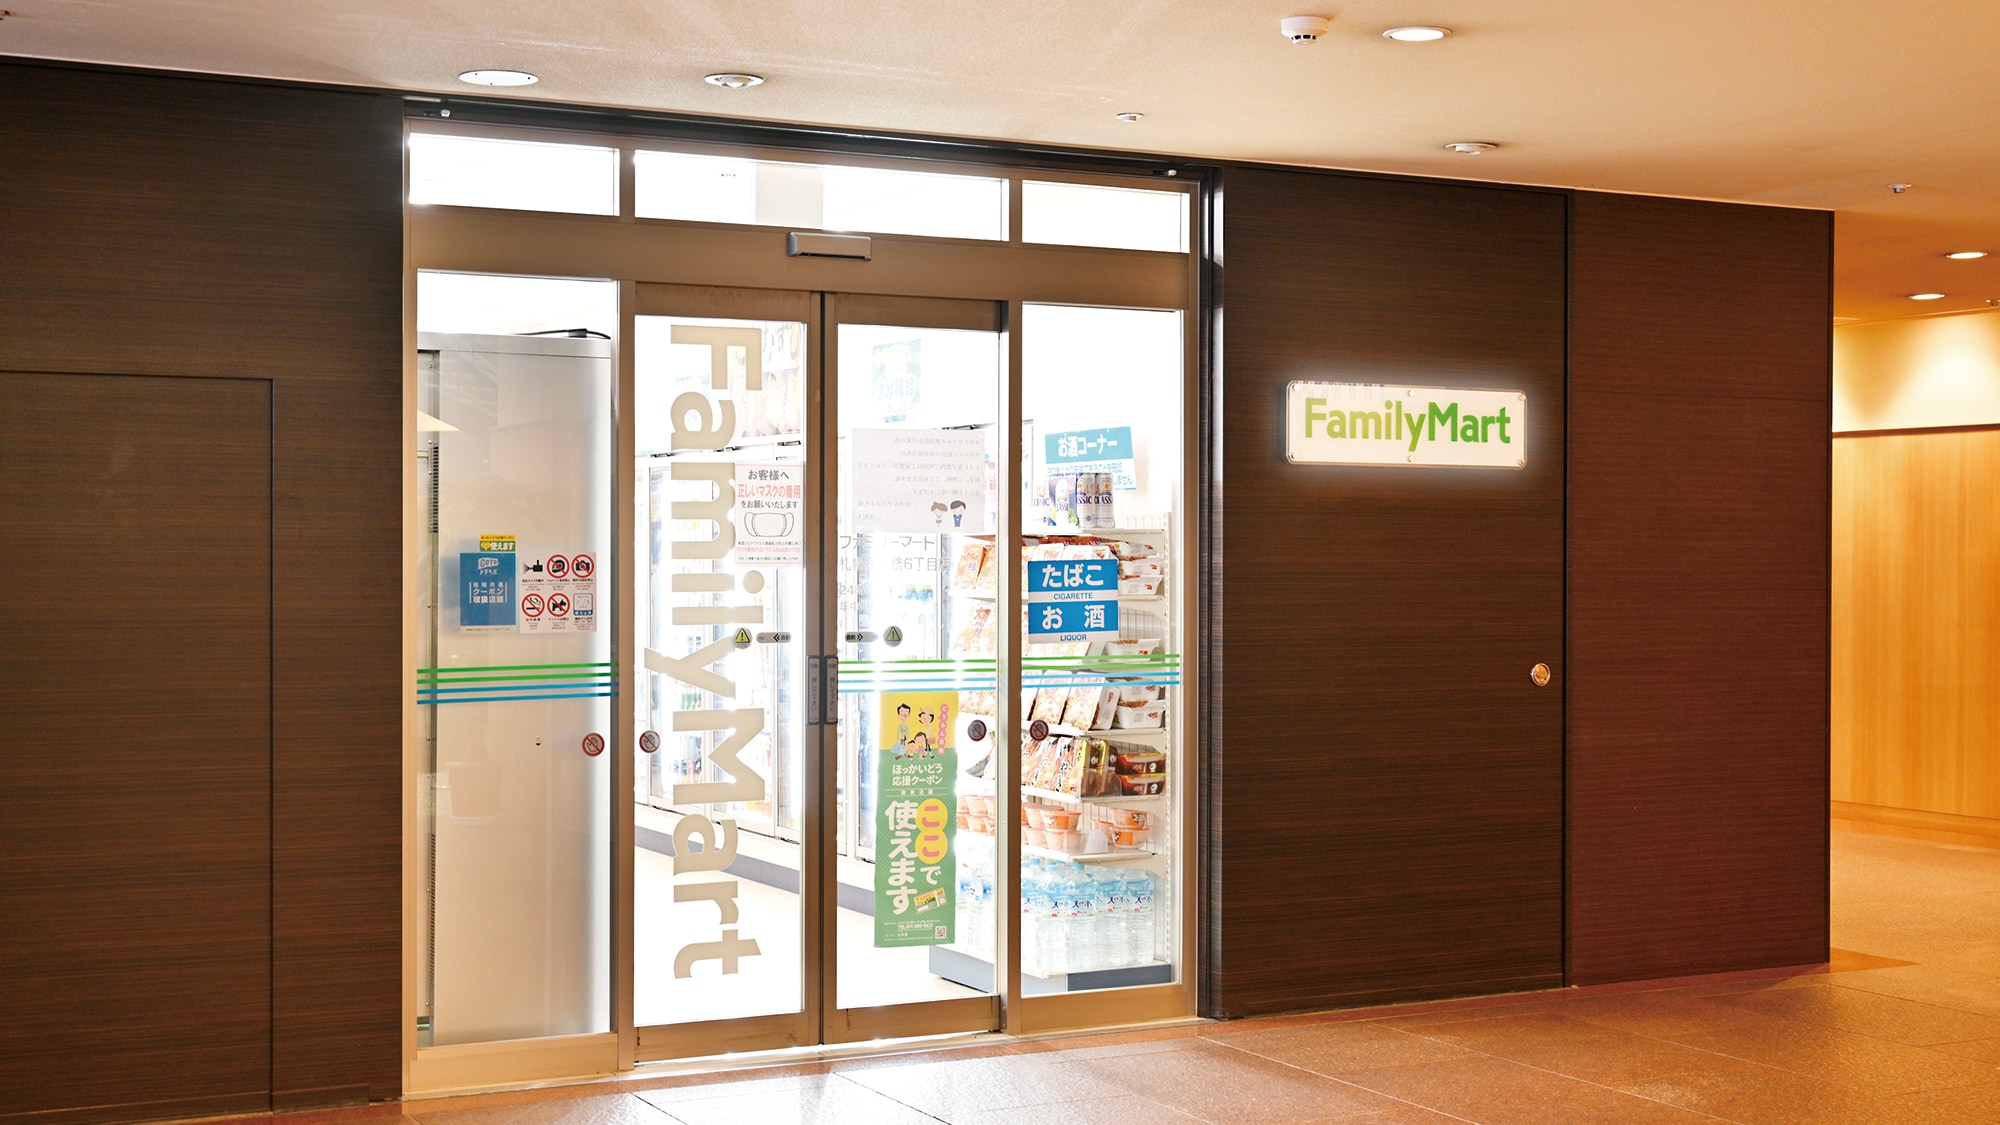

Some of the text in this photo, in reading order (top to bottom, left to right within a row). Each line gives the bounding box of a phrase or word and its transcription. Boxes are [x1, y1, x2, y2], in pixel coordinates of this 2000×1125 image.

[1305, 398, 1511, 452] FamilyMart
[1057, 434, 1118, 457] お酒コーナー
[748, 469, 790, 481] お客様へ
[738, 484, 801, 499] 正しいマスクの着用
[741, 500, 798, 509] をお願いいたします
[1042, 563, 1104, 588] たばこ
[1042, 604, 1105, 630] お酒
[644, 325, 763, 979] FamilyMart
[892, 763, 943, 775] ほっかいどう
[892, 775, 943, 786] 応援クーポン
[920, 805, 942, 885] ここで
[885, 800, 919, 915] 使えます
